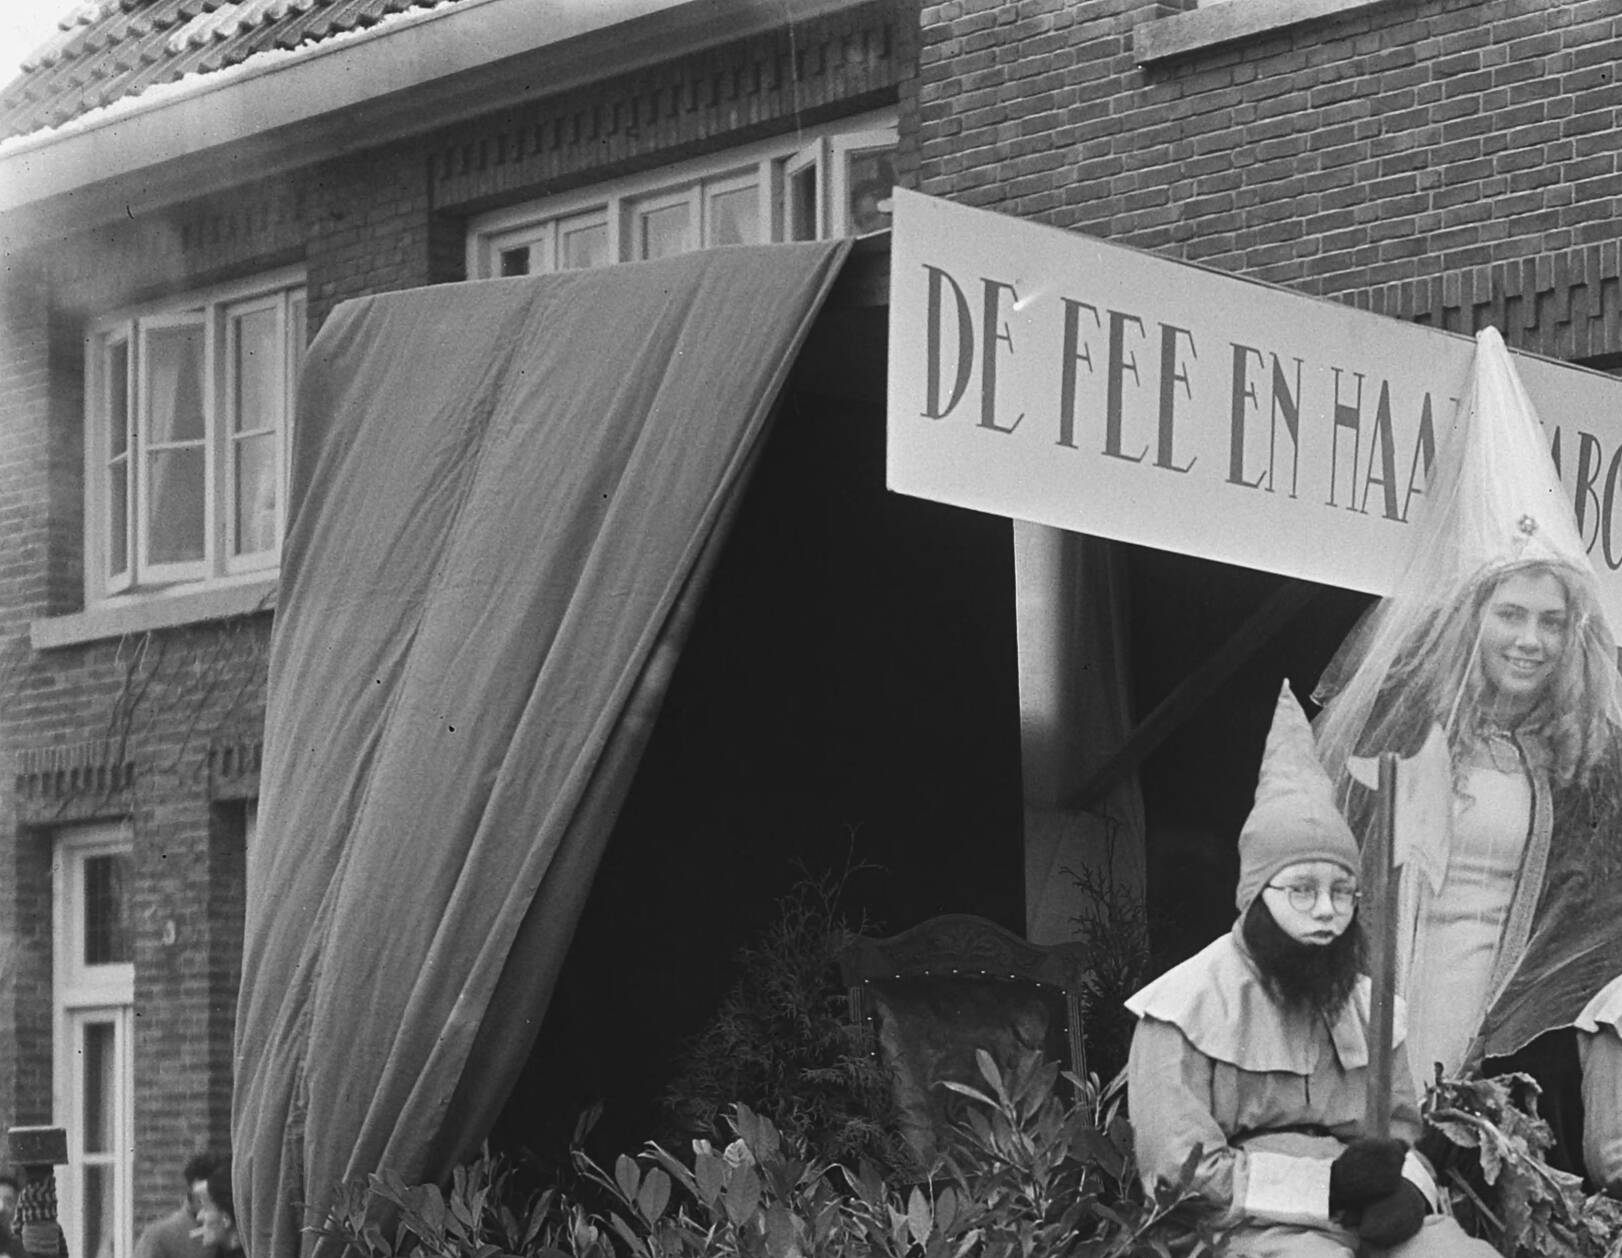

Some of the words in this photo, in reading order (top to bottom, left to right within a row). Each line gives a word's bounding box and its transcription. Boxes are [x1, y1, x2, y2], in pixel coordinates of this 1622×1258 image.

[921, 263, 1023, 433] DE
[1056, 297, 1198, 474] FEE
[1225, 342, 1303, 499] EN
[1326, 366, 1460, 523] HAA
